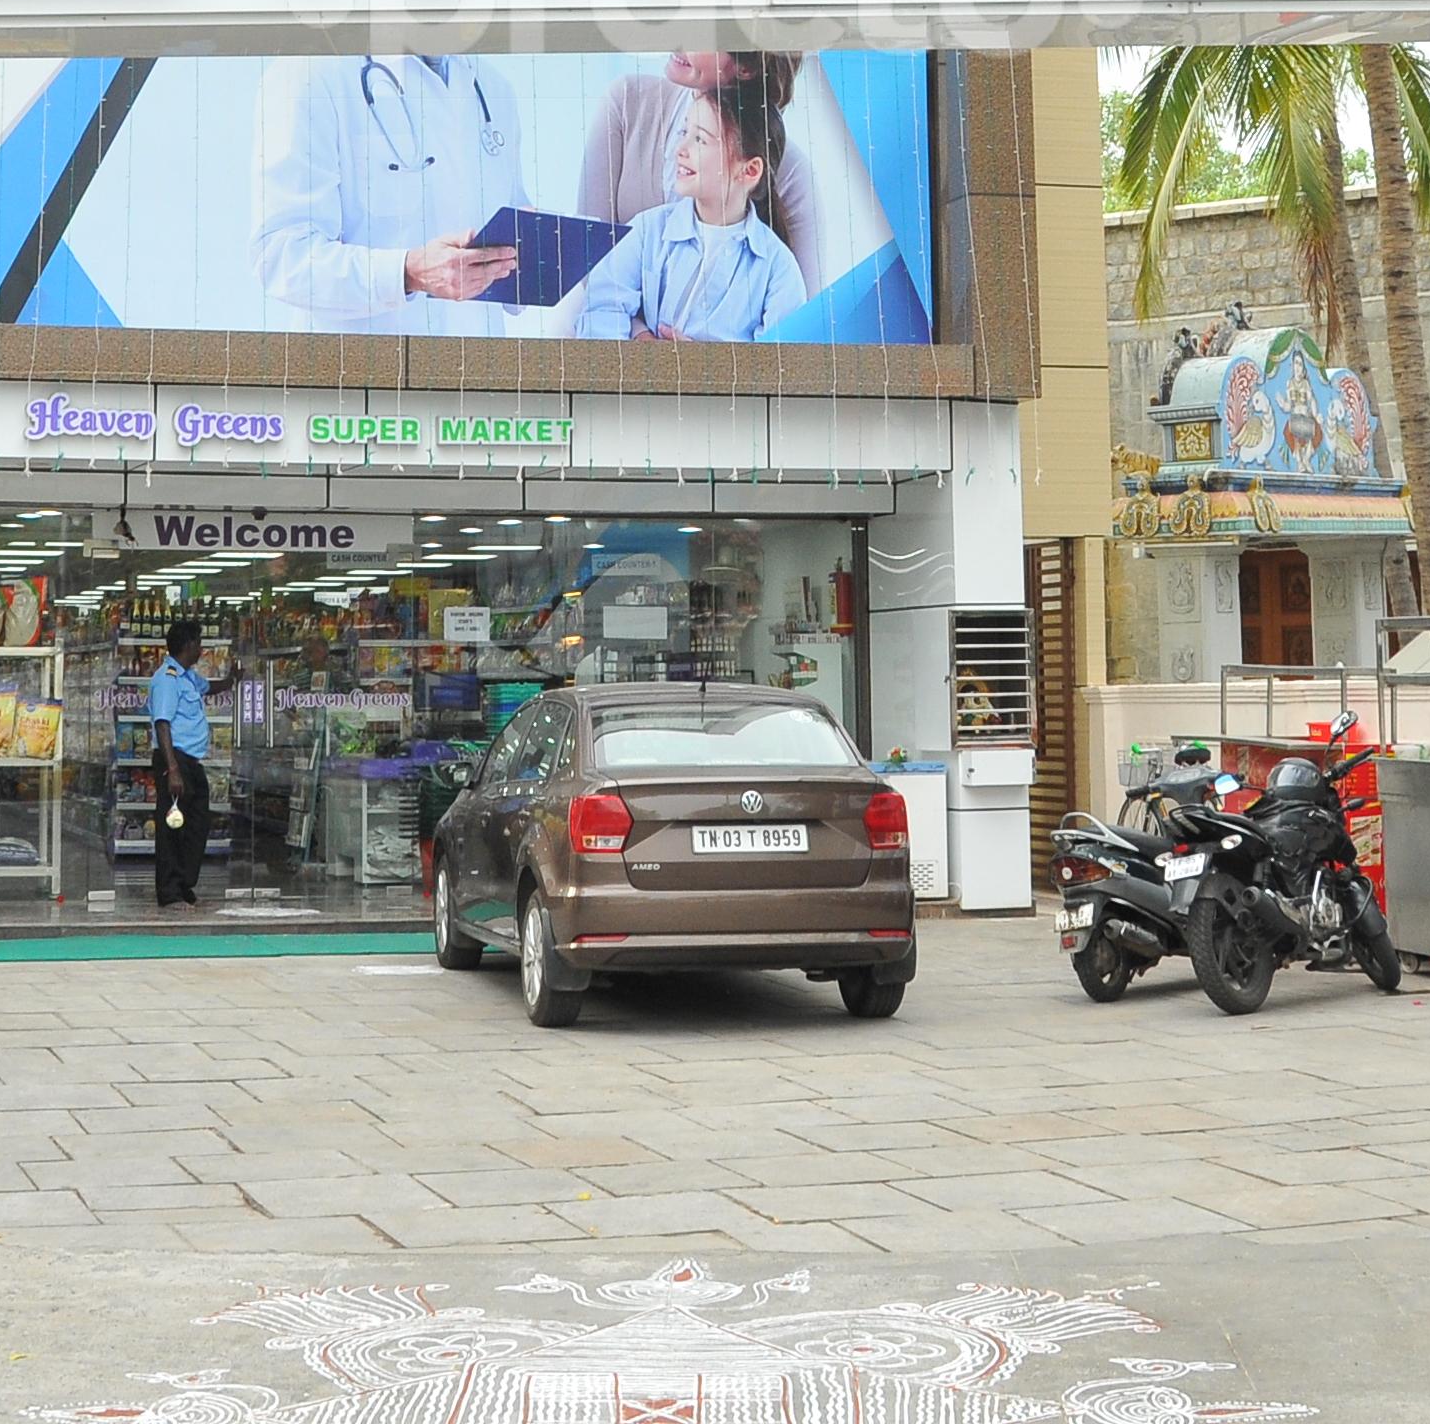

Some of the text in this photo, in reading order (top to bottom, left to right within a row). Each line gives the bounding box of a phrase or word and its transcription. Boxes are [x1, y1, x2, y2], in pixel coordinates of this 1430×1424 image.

[27, 395, 572, 443] Heaven Greens SUPER MARKET
[153, 514, 356, 550] Welcome
[331, 552, 388, 563] CASH COUNTER
[93, 685, 149, 712] Heav
[273, 684, 411, 712] Heaven Greens
[698, 829, 801, 848] TN 03 T 8959
